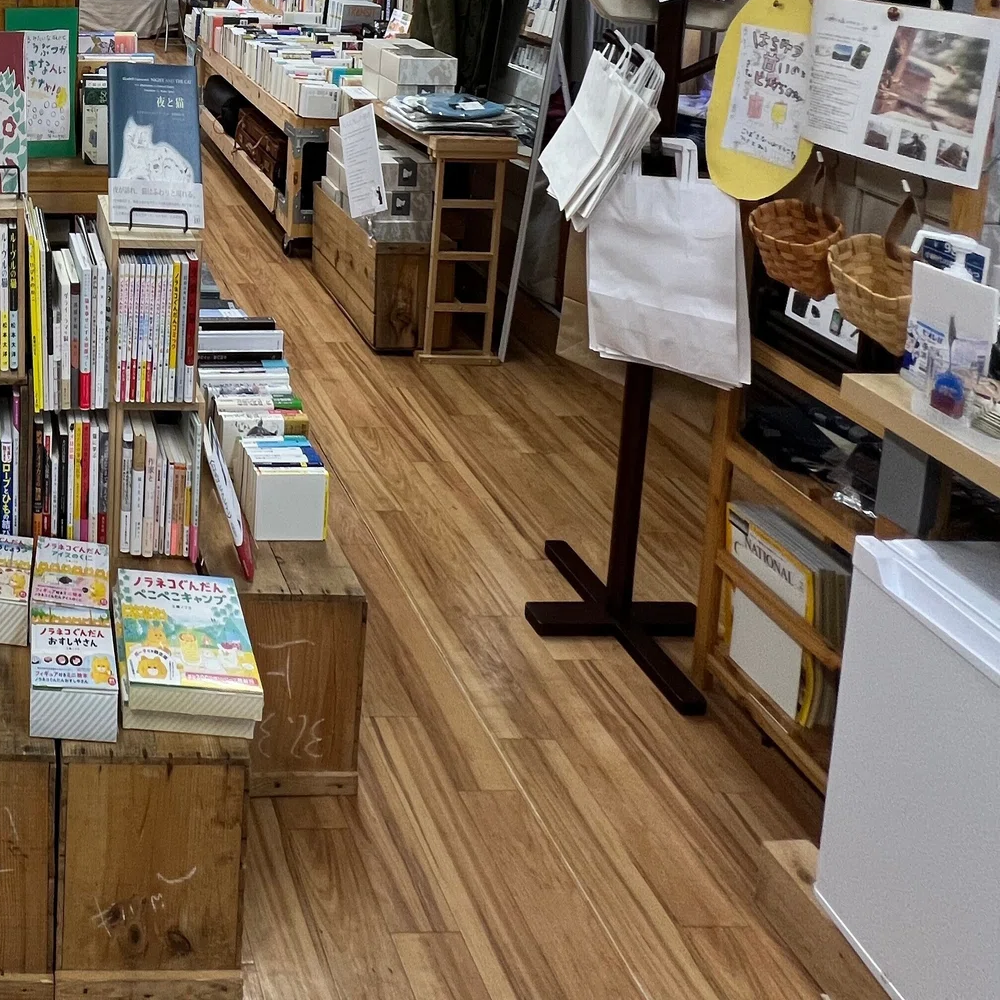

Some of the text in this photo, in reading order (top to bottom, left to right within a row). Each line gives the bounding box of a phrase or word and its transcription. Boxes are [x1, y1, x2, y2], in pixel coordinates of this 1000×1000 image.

[156, 96, 185, 109] 夜と猫
[43, 542, 102, 557] ノラネコぐんだん
[51, 550, 93, 562] アイスのくに
[743, 535, 797, 586] NATIONAL
[133, 576, 224, 594] ノラネコぐんだん
[133, 589, 227, 605] ぺこぺこキャンプ
[39, 627, 105, 639] ノラネコぐんだん
[47, 636, 98, 648] おすしやさん
